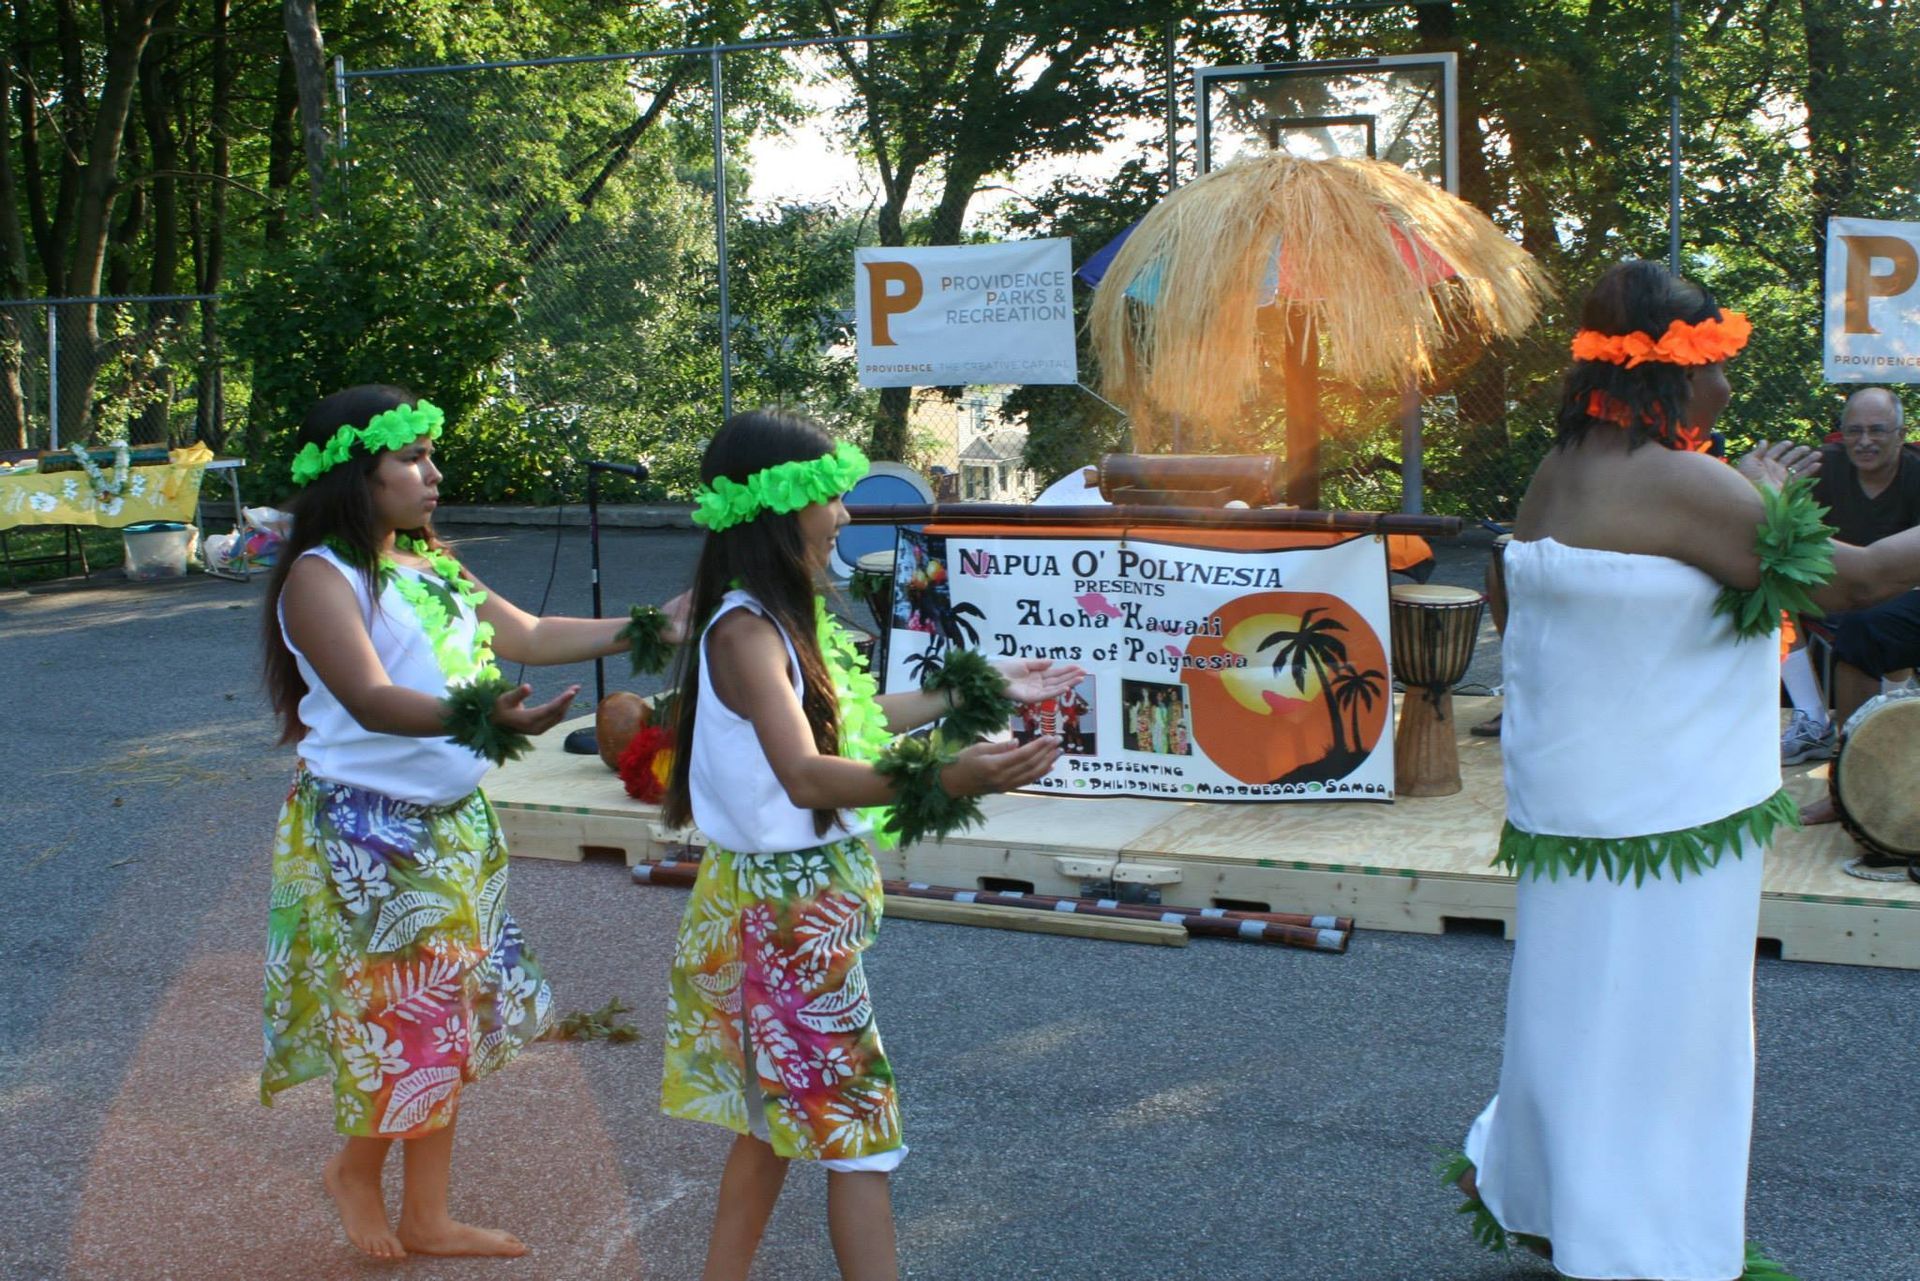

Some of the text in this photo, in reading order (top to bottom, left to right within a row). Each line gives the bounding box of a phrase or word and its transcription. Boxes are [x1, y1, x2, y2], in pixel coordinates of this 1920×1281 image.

[941, 271, 1065, 291] PROVIDENCE
[1837, 235, 1919, 334] P
[862, 261, 924, 346] P
[986, 288, 1066, 306] PARKS &
[946, 306, 1067, 325] RECREATION
[865, 363, 933, 373] PROVIDENCE
[958, 548, 1283, 588] NAPUA O' POLYNESIA
[1074, 580, 1165, 597] PRESENTS
[1016, 599, 1222, 636] Aloha Hawaii
[995, 633, 1248, 673] Drums of Polynesia
[1069, 759, 1183, 776] REPRESENTING
[1325, 780, 1386, 794] SAMOA
